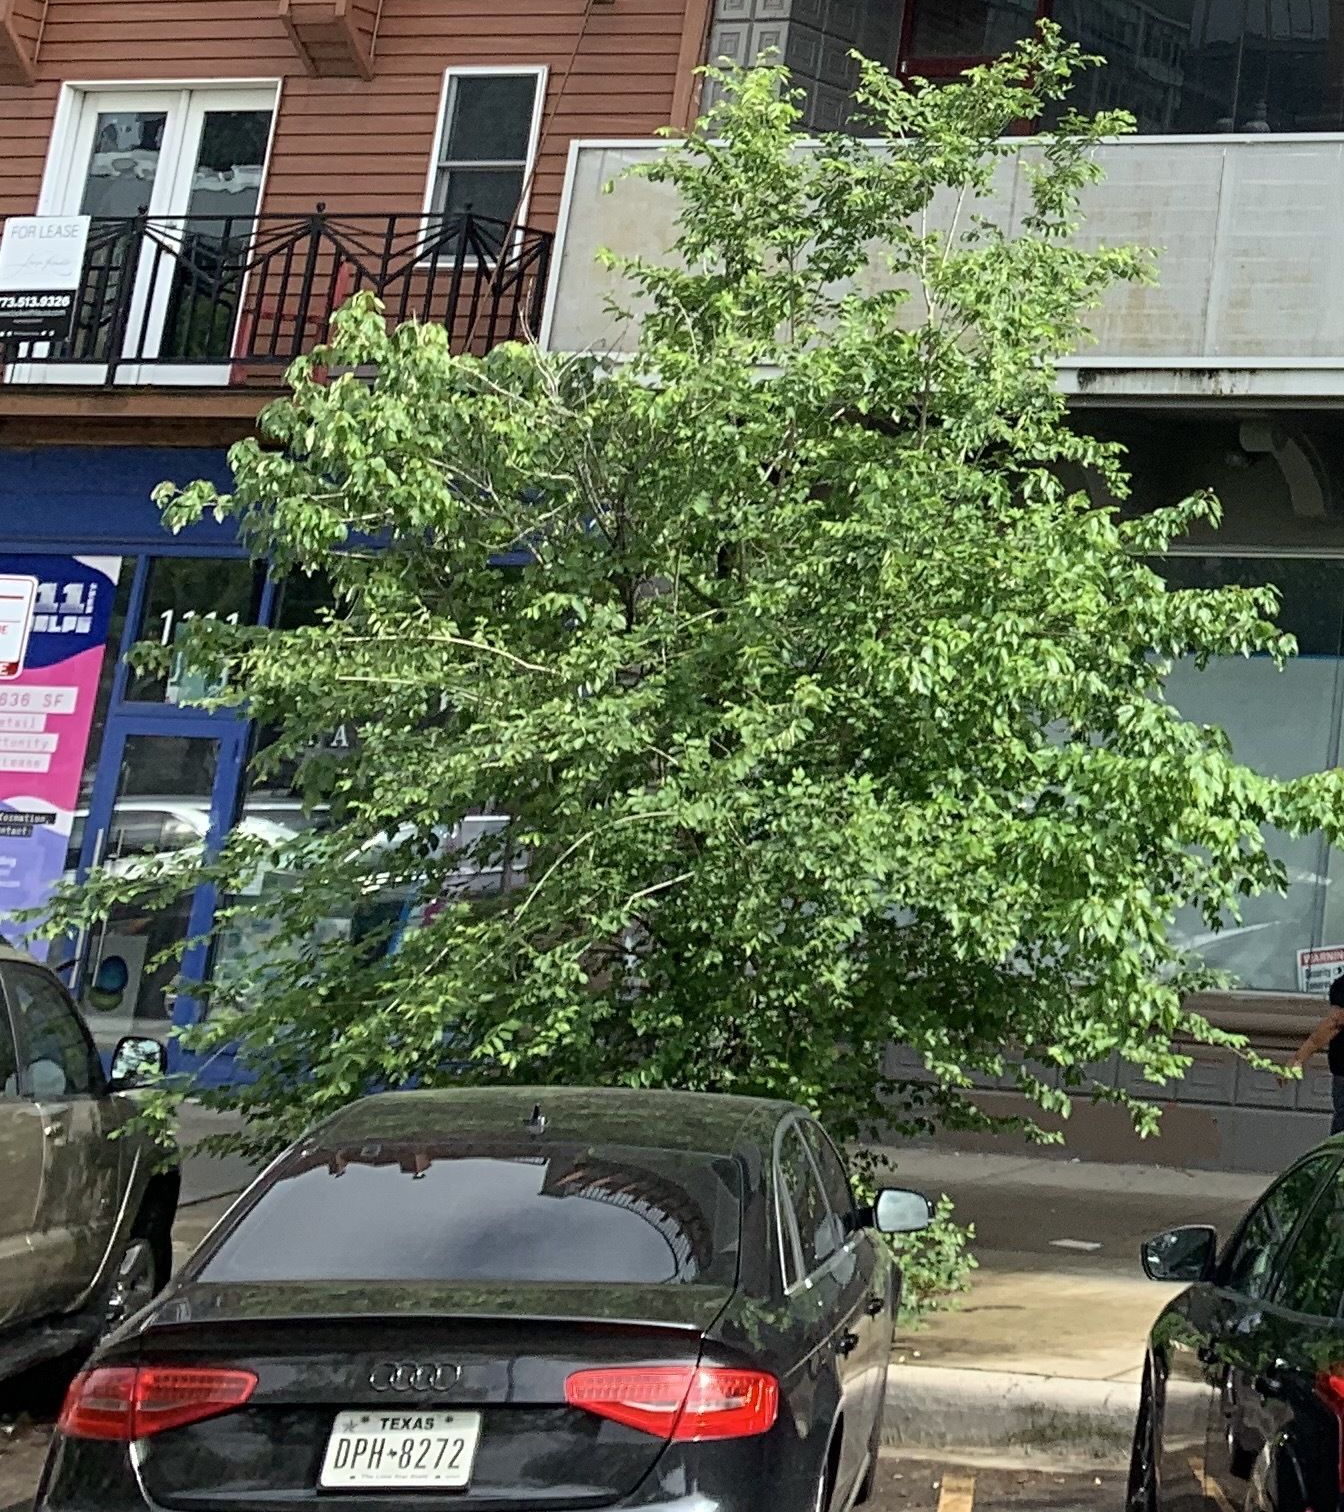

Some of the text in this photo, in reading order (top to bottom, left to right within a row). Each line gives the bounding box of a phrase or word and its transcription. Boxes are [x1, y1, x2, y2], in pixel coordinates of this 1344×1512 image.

[11, 224, 80, 240] FOR LEASE
[0, 295, 71, 308] 73.513.9326
[43, 694, 64, 708] SF
[380, 1417, 435, 1430] TEXAS
